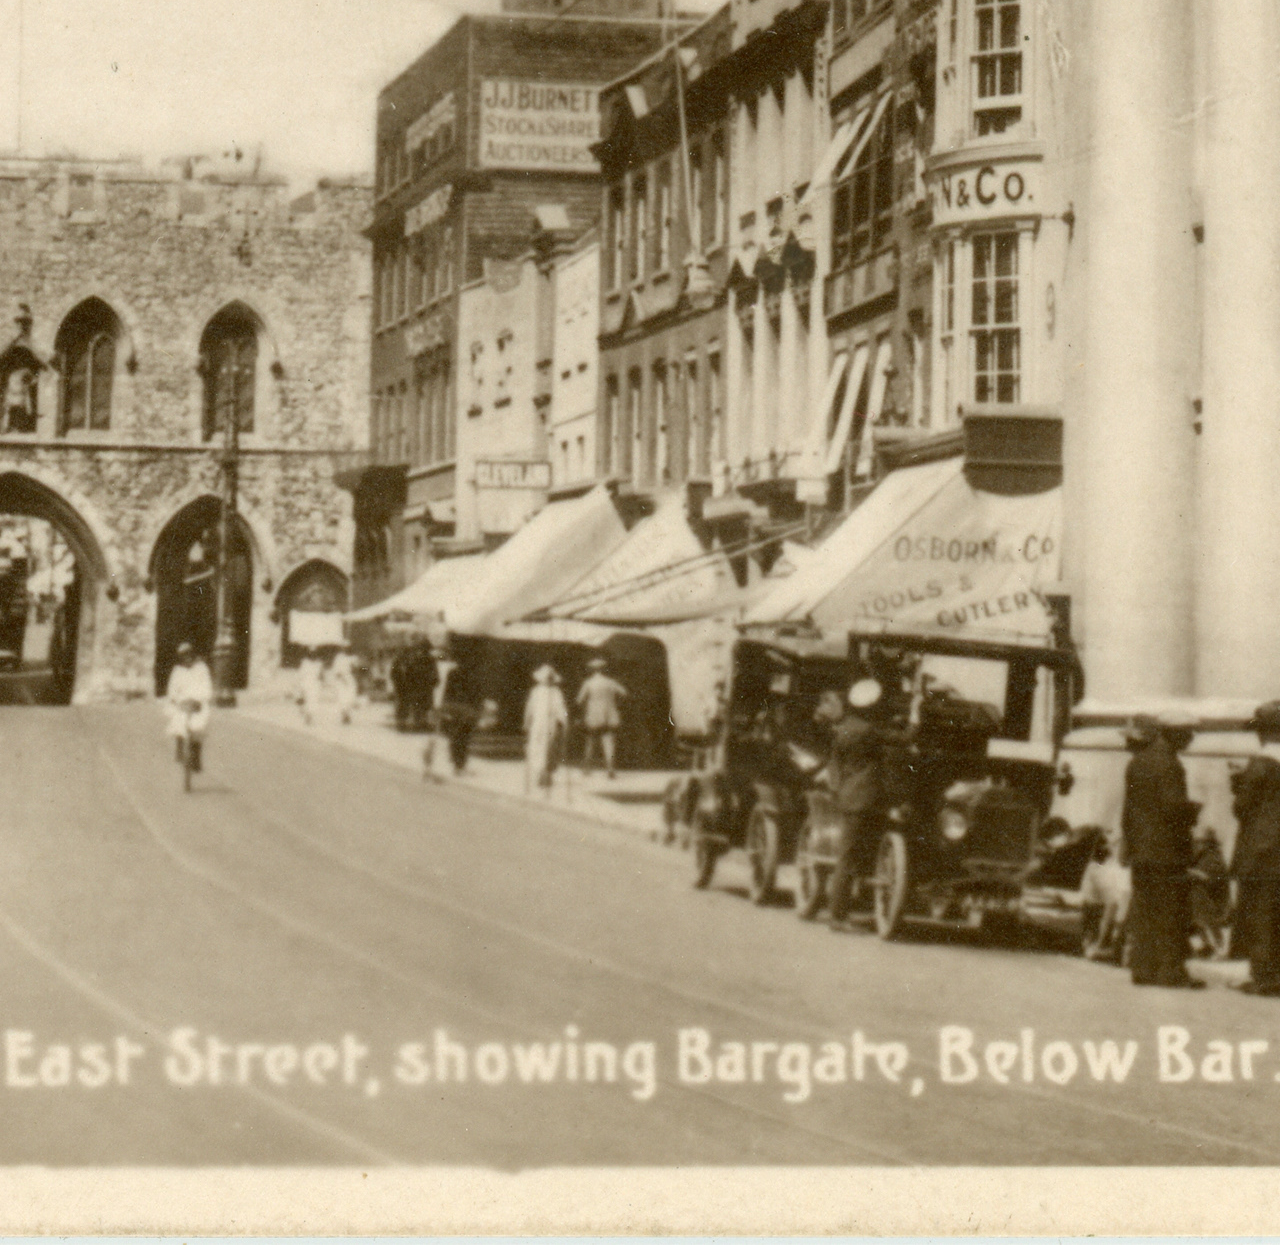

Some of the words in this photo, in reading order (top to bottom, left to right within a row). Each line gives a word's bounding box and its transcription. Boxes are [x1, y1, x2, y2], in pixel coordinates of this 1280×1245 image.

[956, 178, 970, 207] &
[894, 531, 998, 563] OSBORN
[859, 578, 944, 617] TOOLS
[935, 587, 1048, 628] CUTLERY
